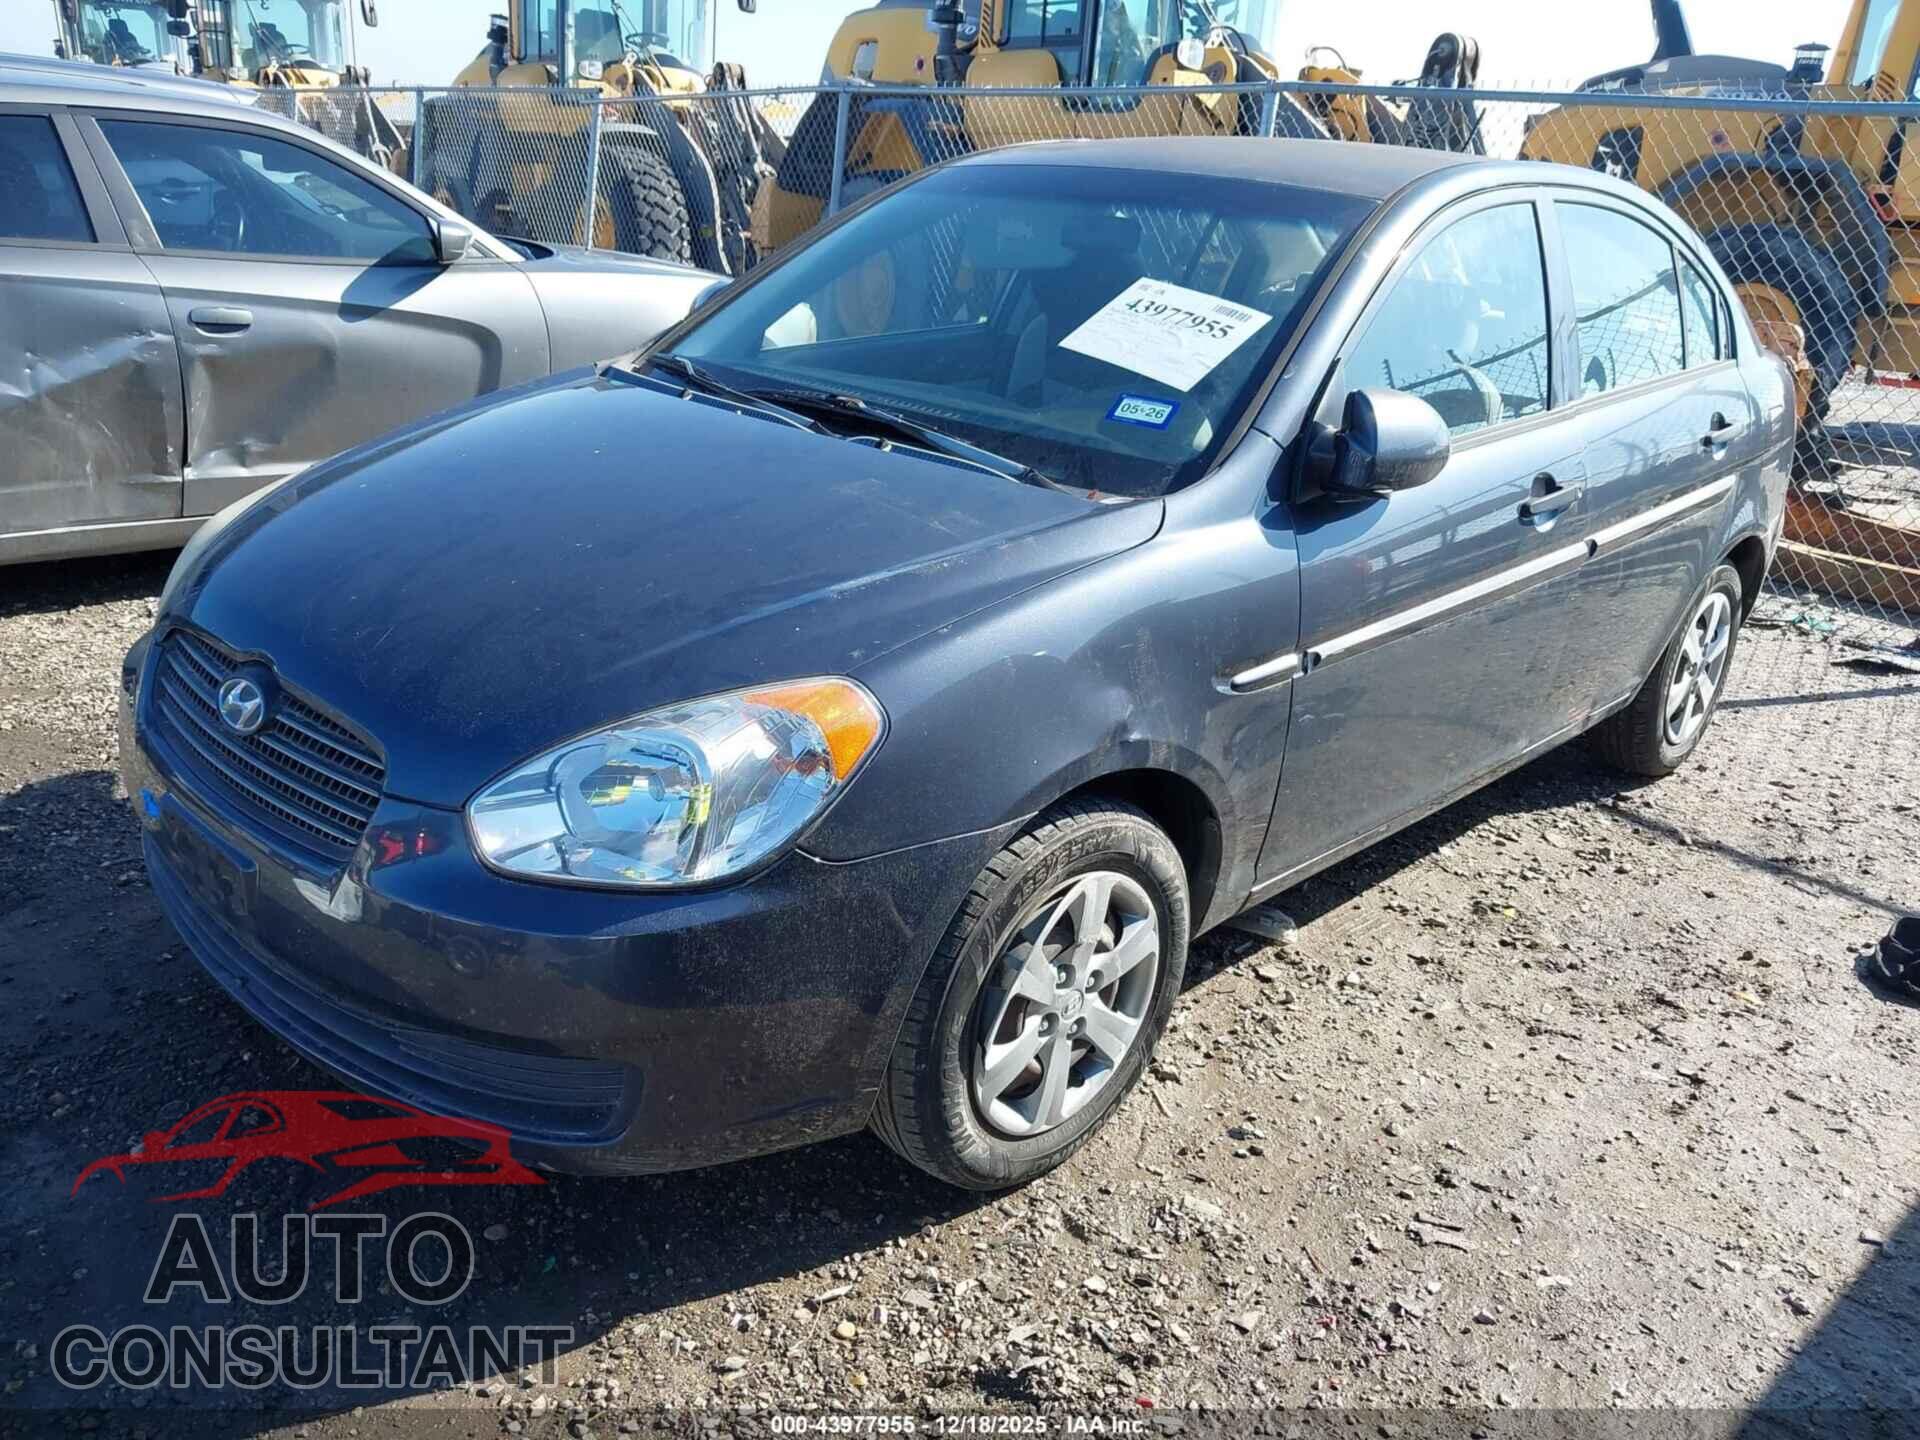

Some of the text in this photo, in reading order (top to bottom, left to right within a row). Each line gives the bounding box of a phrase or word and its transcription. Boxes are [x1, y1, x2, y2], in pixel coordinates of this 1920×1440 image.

[1125, 299, 1235, 339] 43977955
[1120, 402, 1167, 419] 05 26
